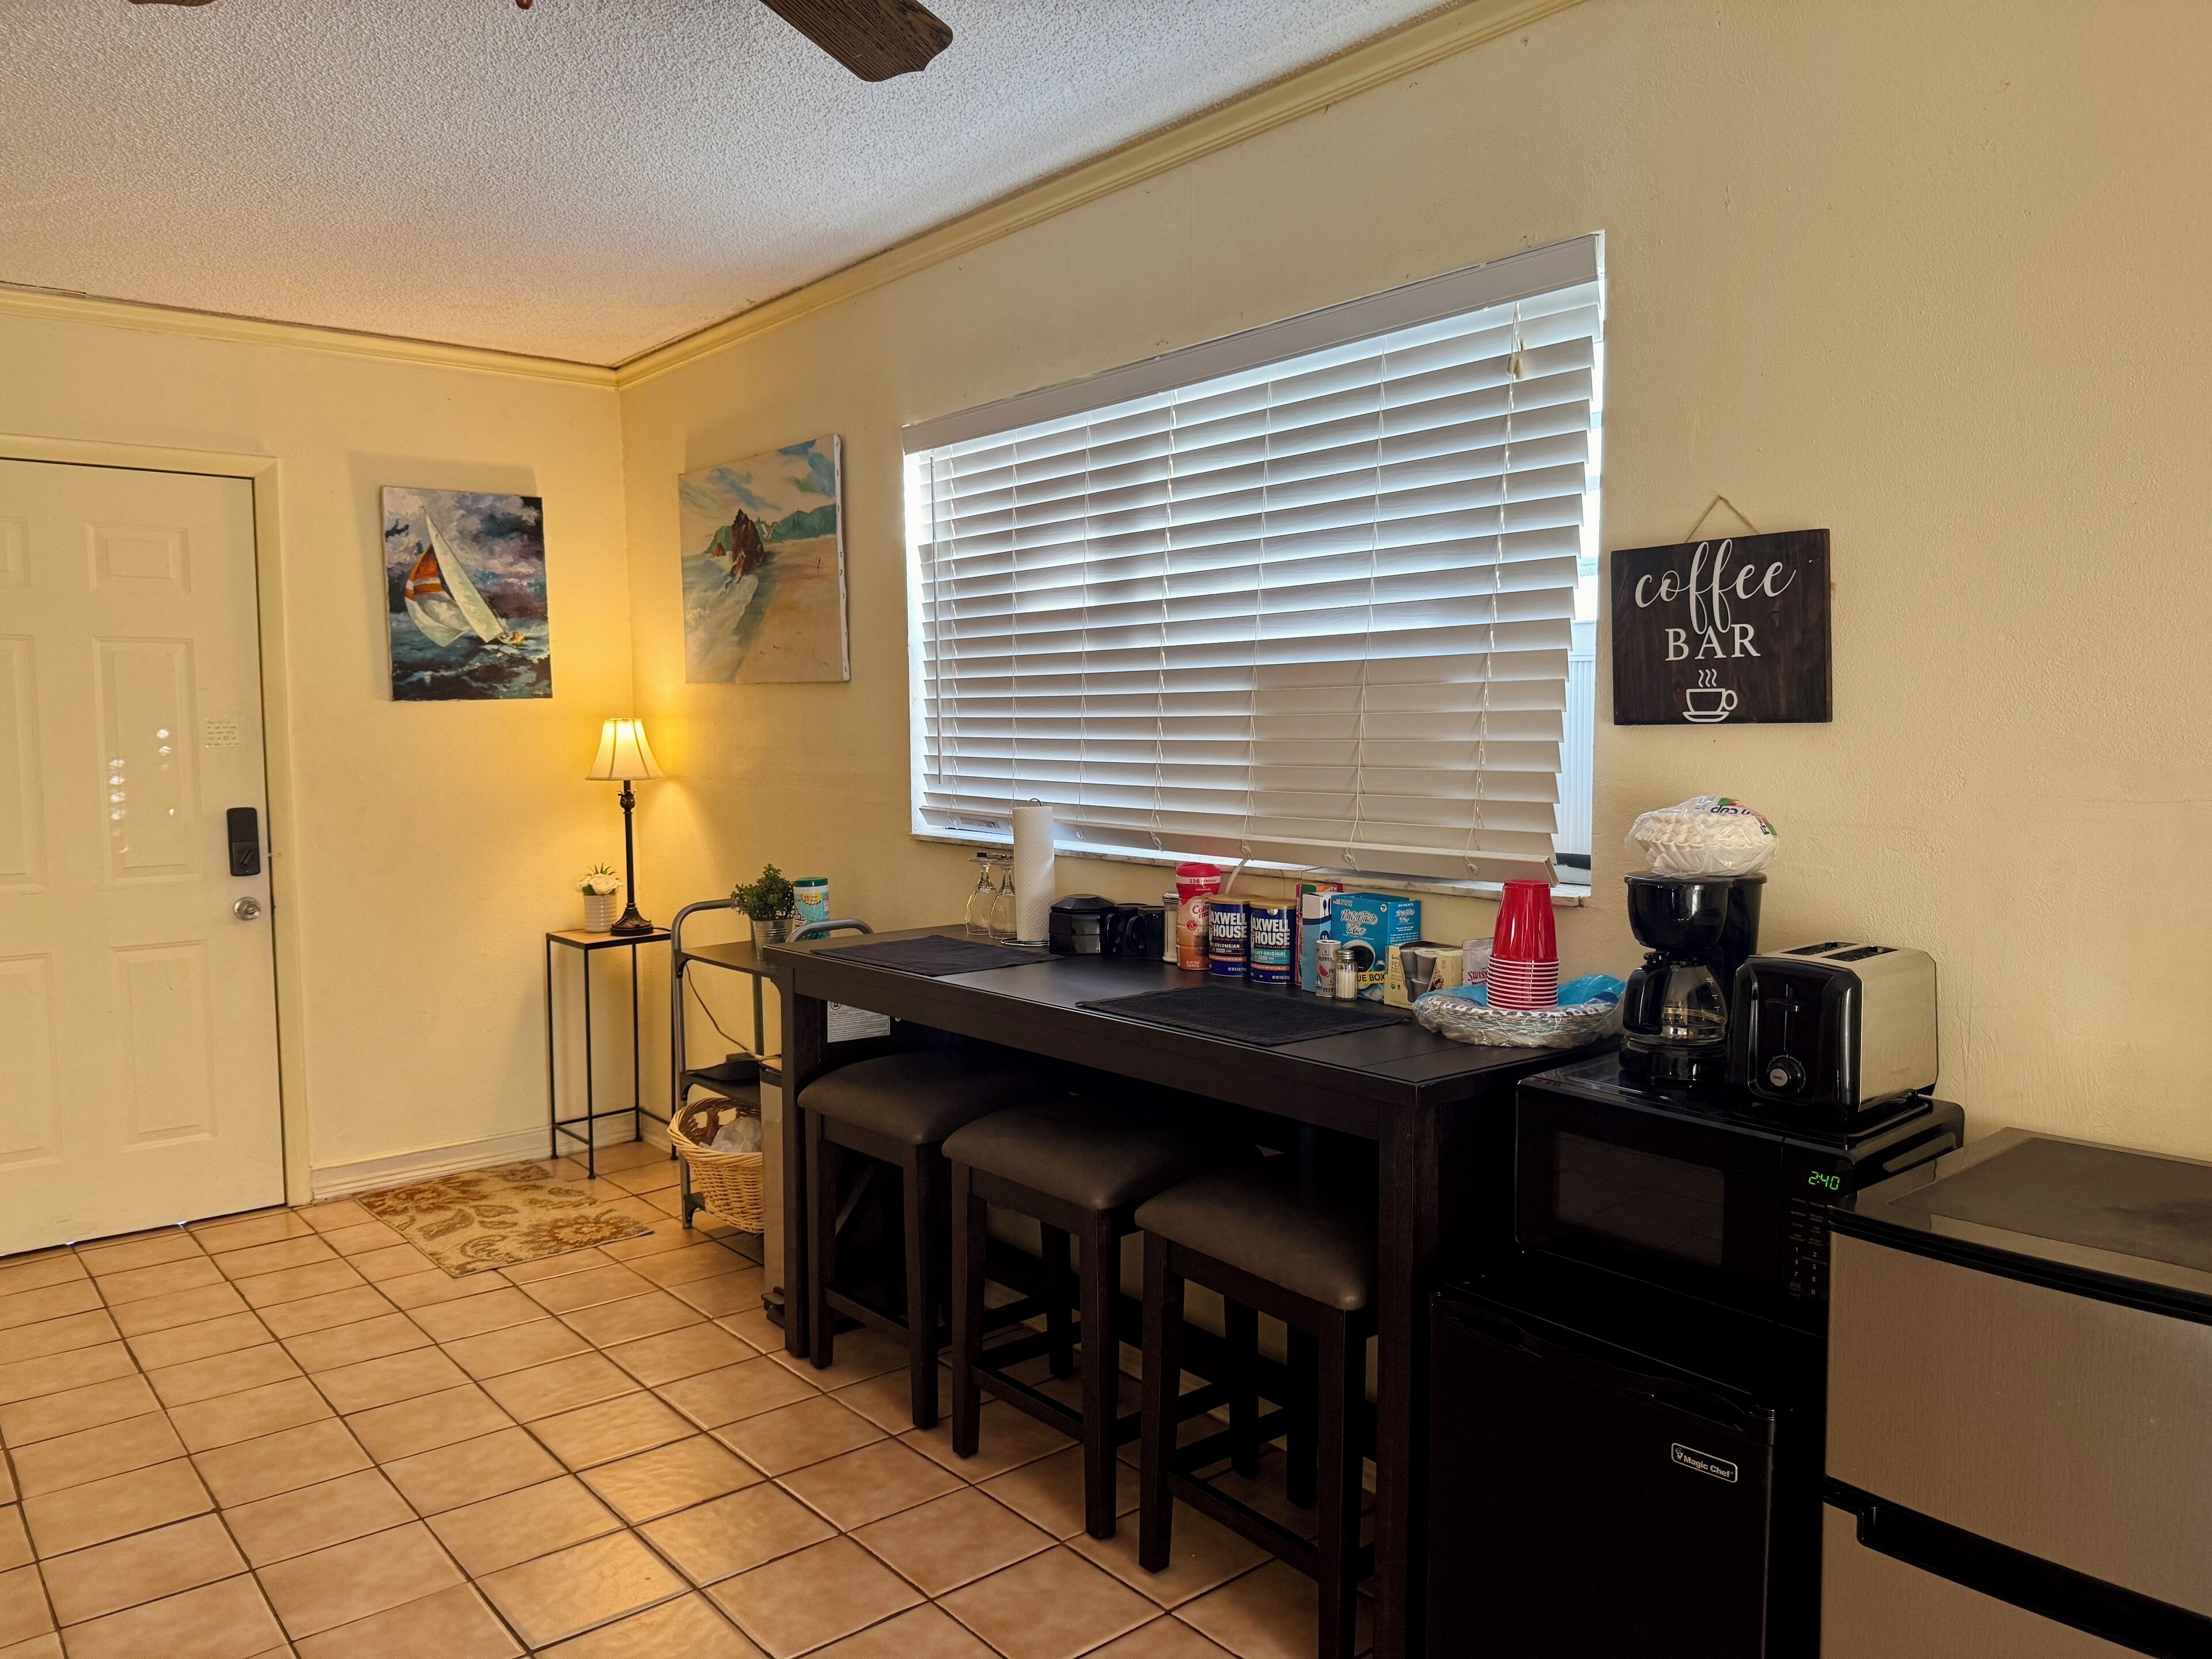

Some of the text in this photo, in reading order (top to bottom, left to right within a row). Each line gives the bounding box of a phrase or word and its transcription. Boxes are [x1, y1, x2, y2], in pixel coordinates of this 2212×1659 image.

[1635, 539, 1796, 634] coffee
[1665, 623, 1761, 661] BAR
[1192, 905, 1210, 914] Coffe
[1209, 910, 1247, 925] AXWELL
[1251, 916, 1290, 932] AXWELL
[1213, 924, 1247, 938] HOUSE
[1346, 922, 1366, 935] Blue
[1255, 931, 1290, 945] HOUSE
[1468, 971, 1488, 981] SWISS
[1808, 1171, 1840, 1190] 2:40
[1683, 1455, 1730, 1478] Magic Chef
